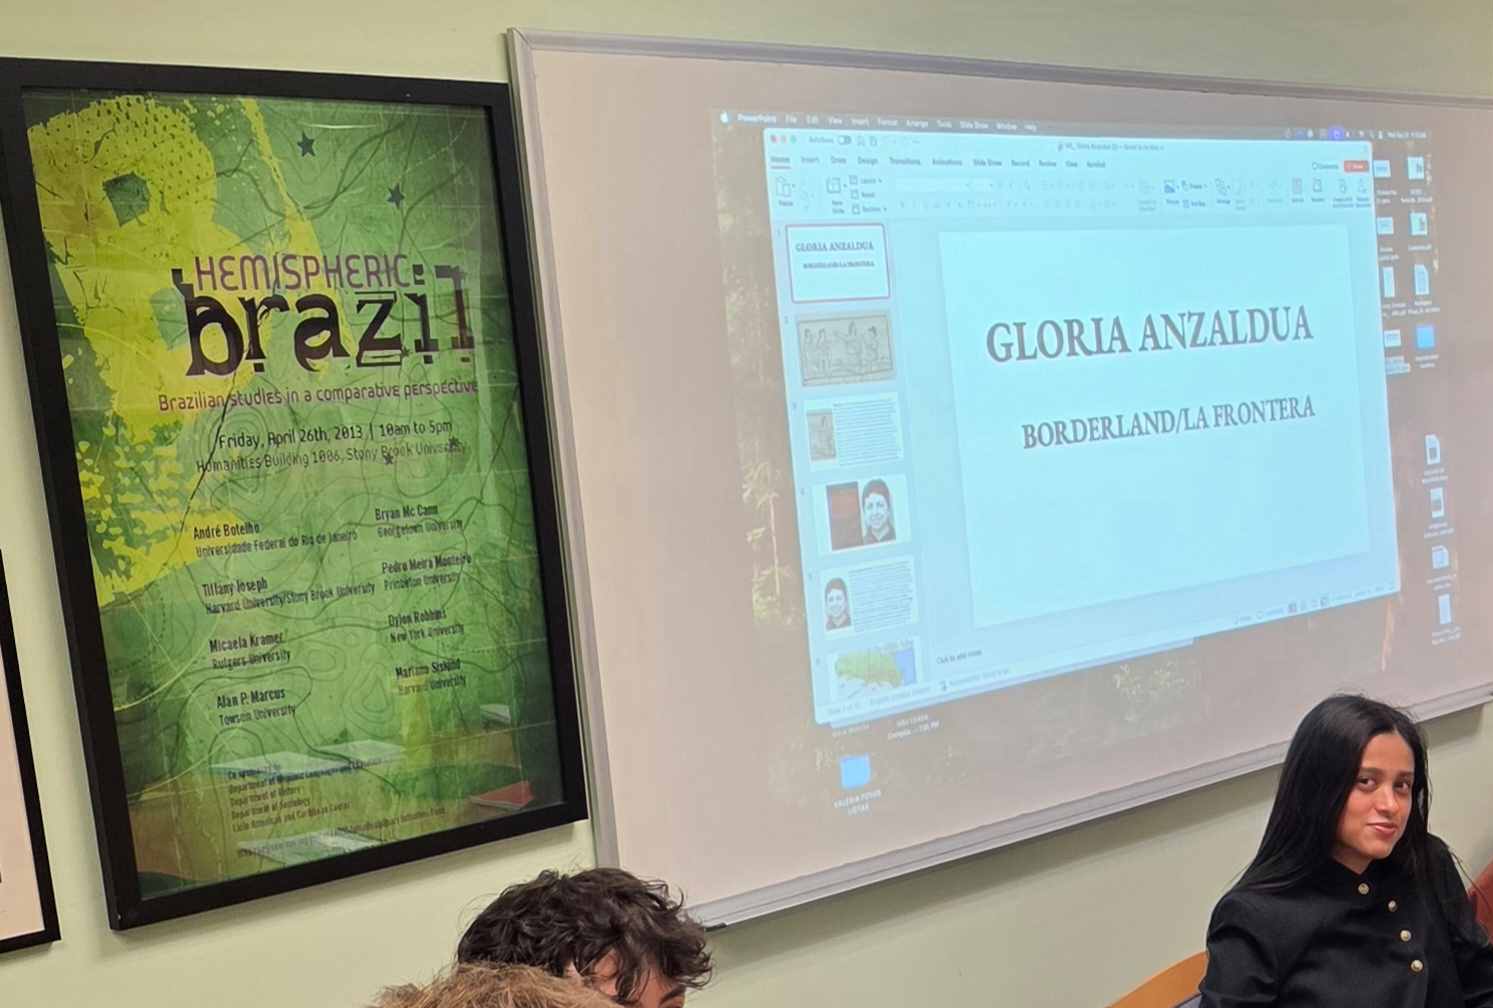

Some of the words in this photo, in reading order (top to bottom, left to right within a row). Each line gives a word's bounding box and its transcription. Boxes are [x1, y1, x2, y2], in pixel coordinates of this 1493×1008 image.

[195, 253, 410, 292] HEMISPHERIC
[171, 264, 475, 377] brazil
[985, 314, 1132, 363] GLORIA
[1138, 305, 1315, 352] ANZALDUA
[159, 391, 227, 412] Brazilian
[230, 389, 282, 407] studies
[286, 387, 298, 403] in
[304, 390, 312, 402] a
[316, 383, 401, 406] comparative
[403, 378, 479, 402] perspective
[219, 432, 265, 450] Friday,
[268, 430, 296, 448] April
[299, 428, 331, 443] 26th,
[334, 426, 363, 439] 2013
[413, 423, 426, 435] to
[429, 419, 453, 435] 5pm
[1021, 406, 1209, 450] BORDERLAND/LA
[1212, 395, 1316, 430] FRONTERA
[193, 526, 221, 541] André
[209, 635, 248, 653] Micaela
[216, 695, 239, 709] Alan
[250, 688, 286, 704] Marcus
